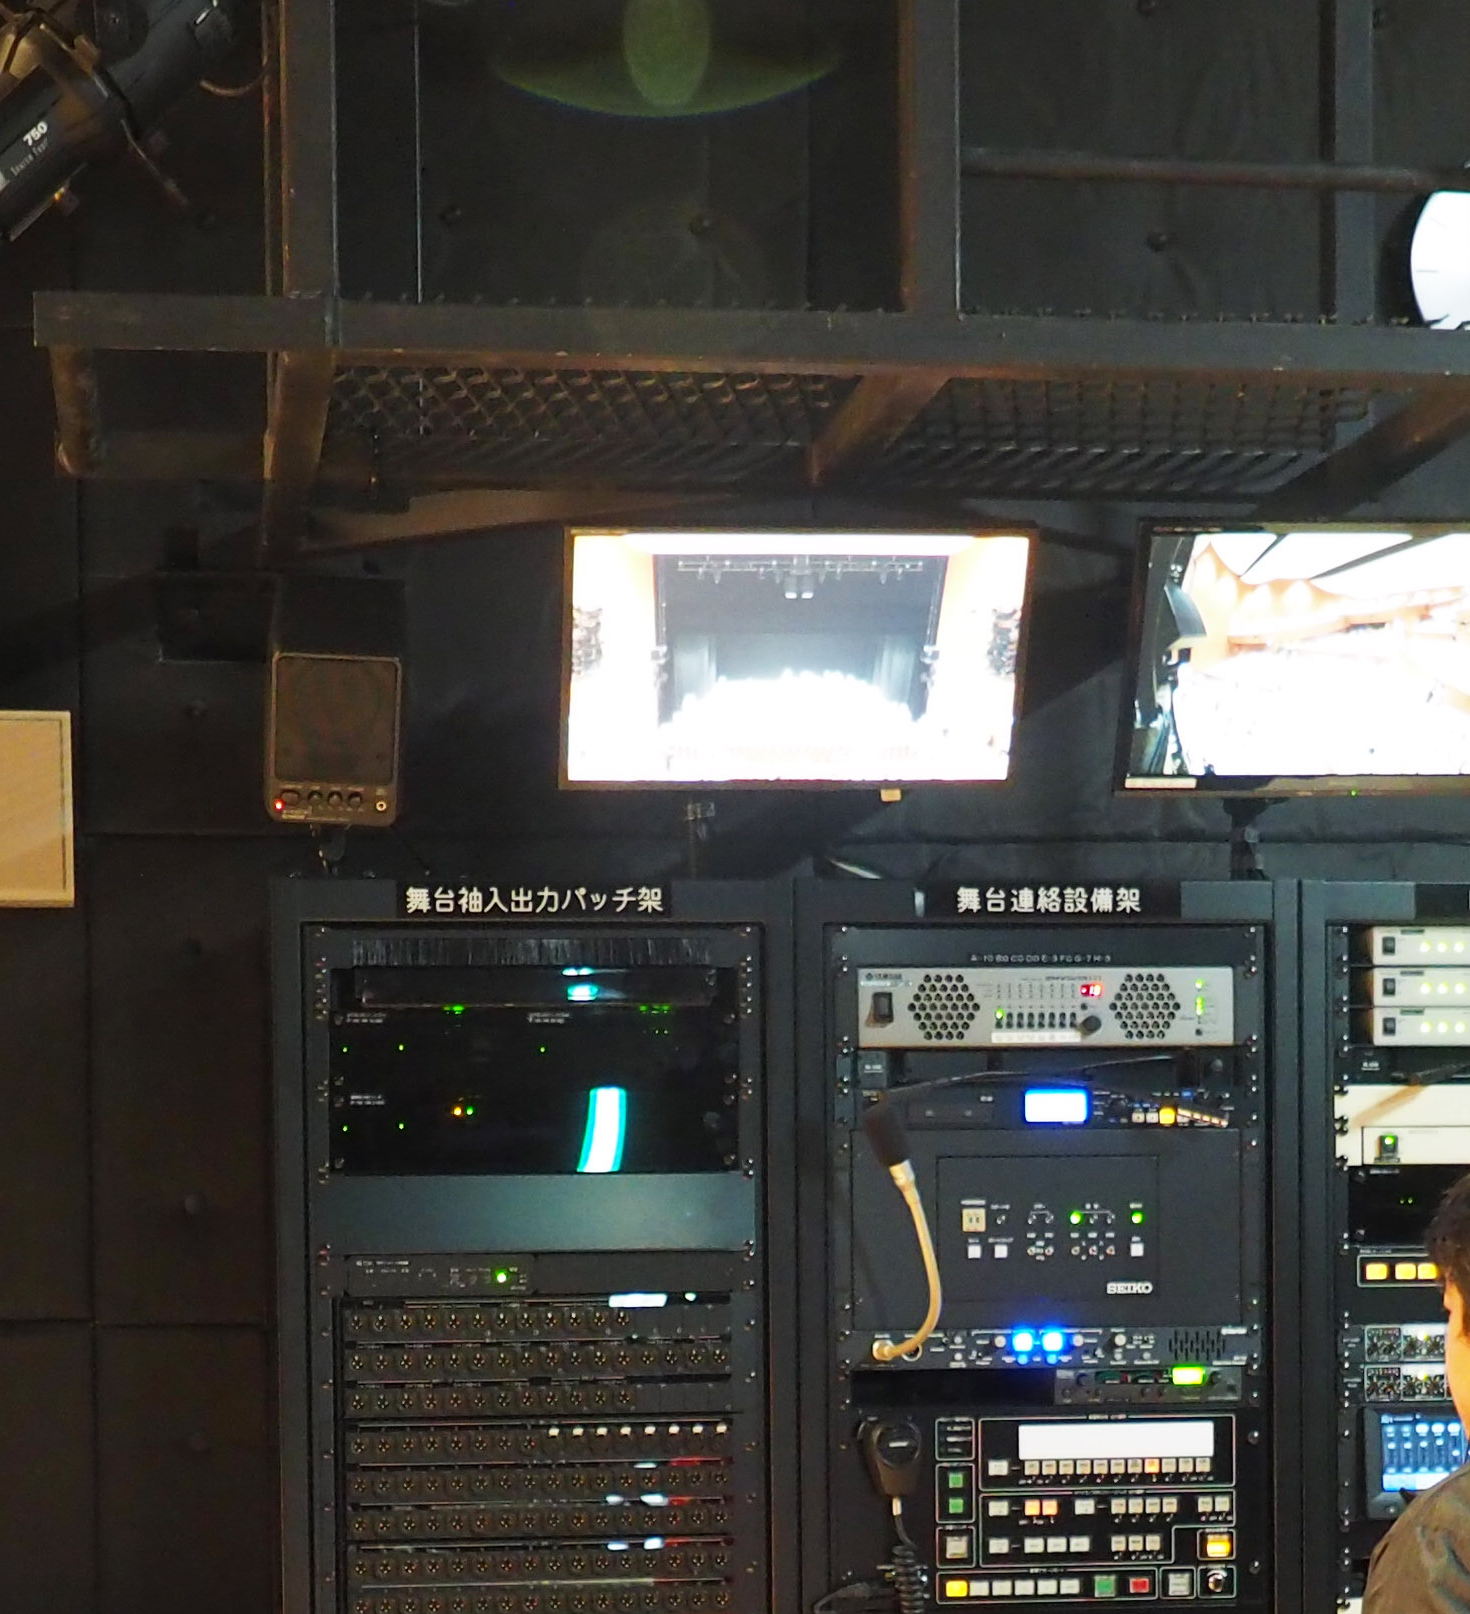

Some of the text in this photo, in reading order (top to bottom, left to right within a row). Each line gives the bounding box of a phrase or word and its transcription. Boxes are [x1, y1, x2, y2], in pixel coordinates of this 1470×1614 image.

[23, 121, 48, 147] 750
[406, 886, 664, 914] 舞台袖入出力パッチ架
[956, 886, 1142, 914] 舞台連絡設備架
[1106, 1281, 1154, 1295] SEIKO
